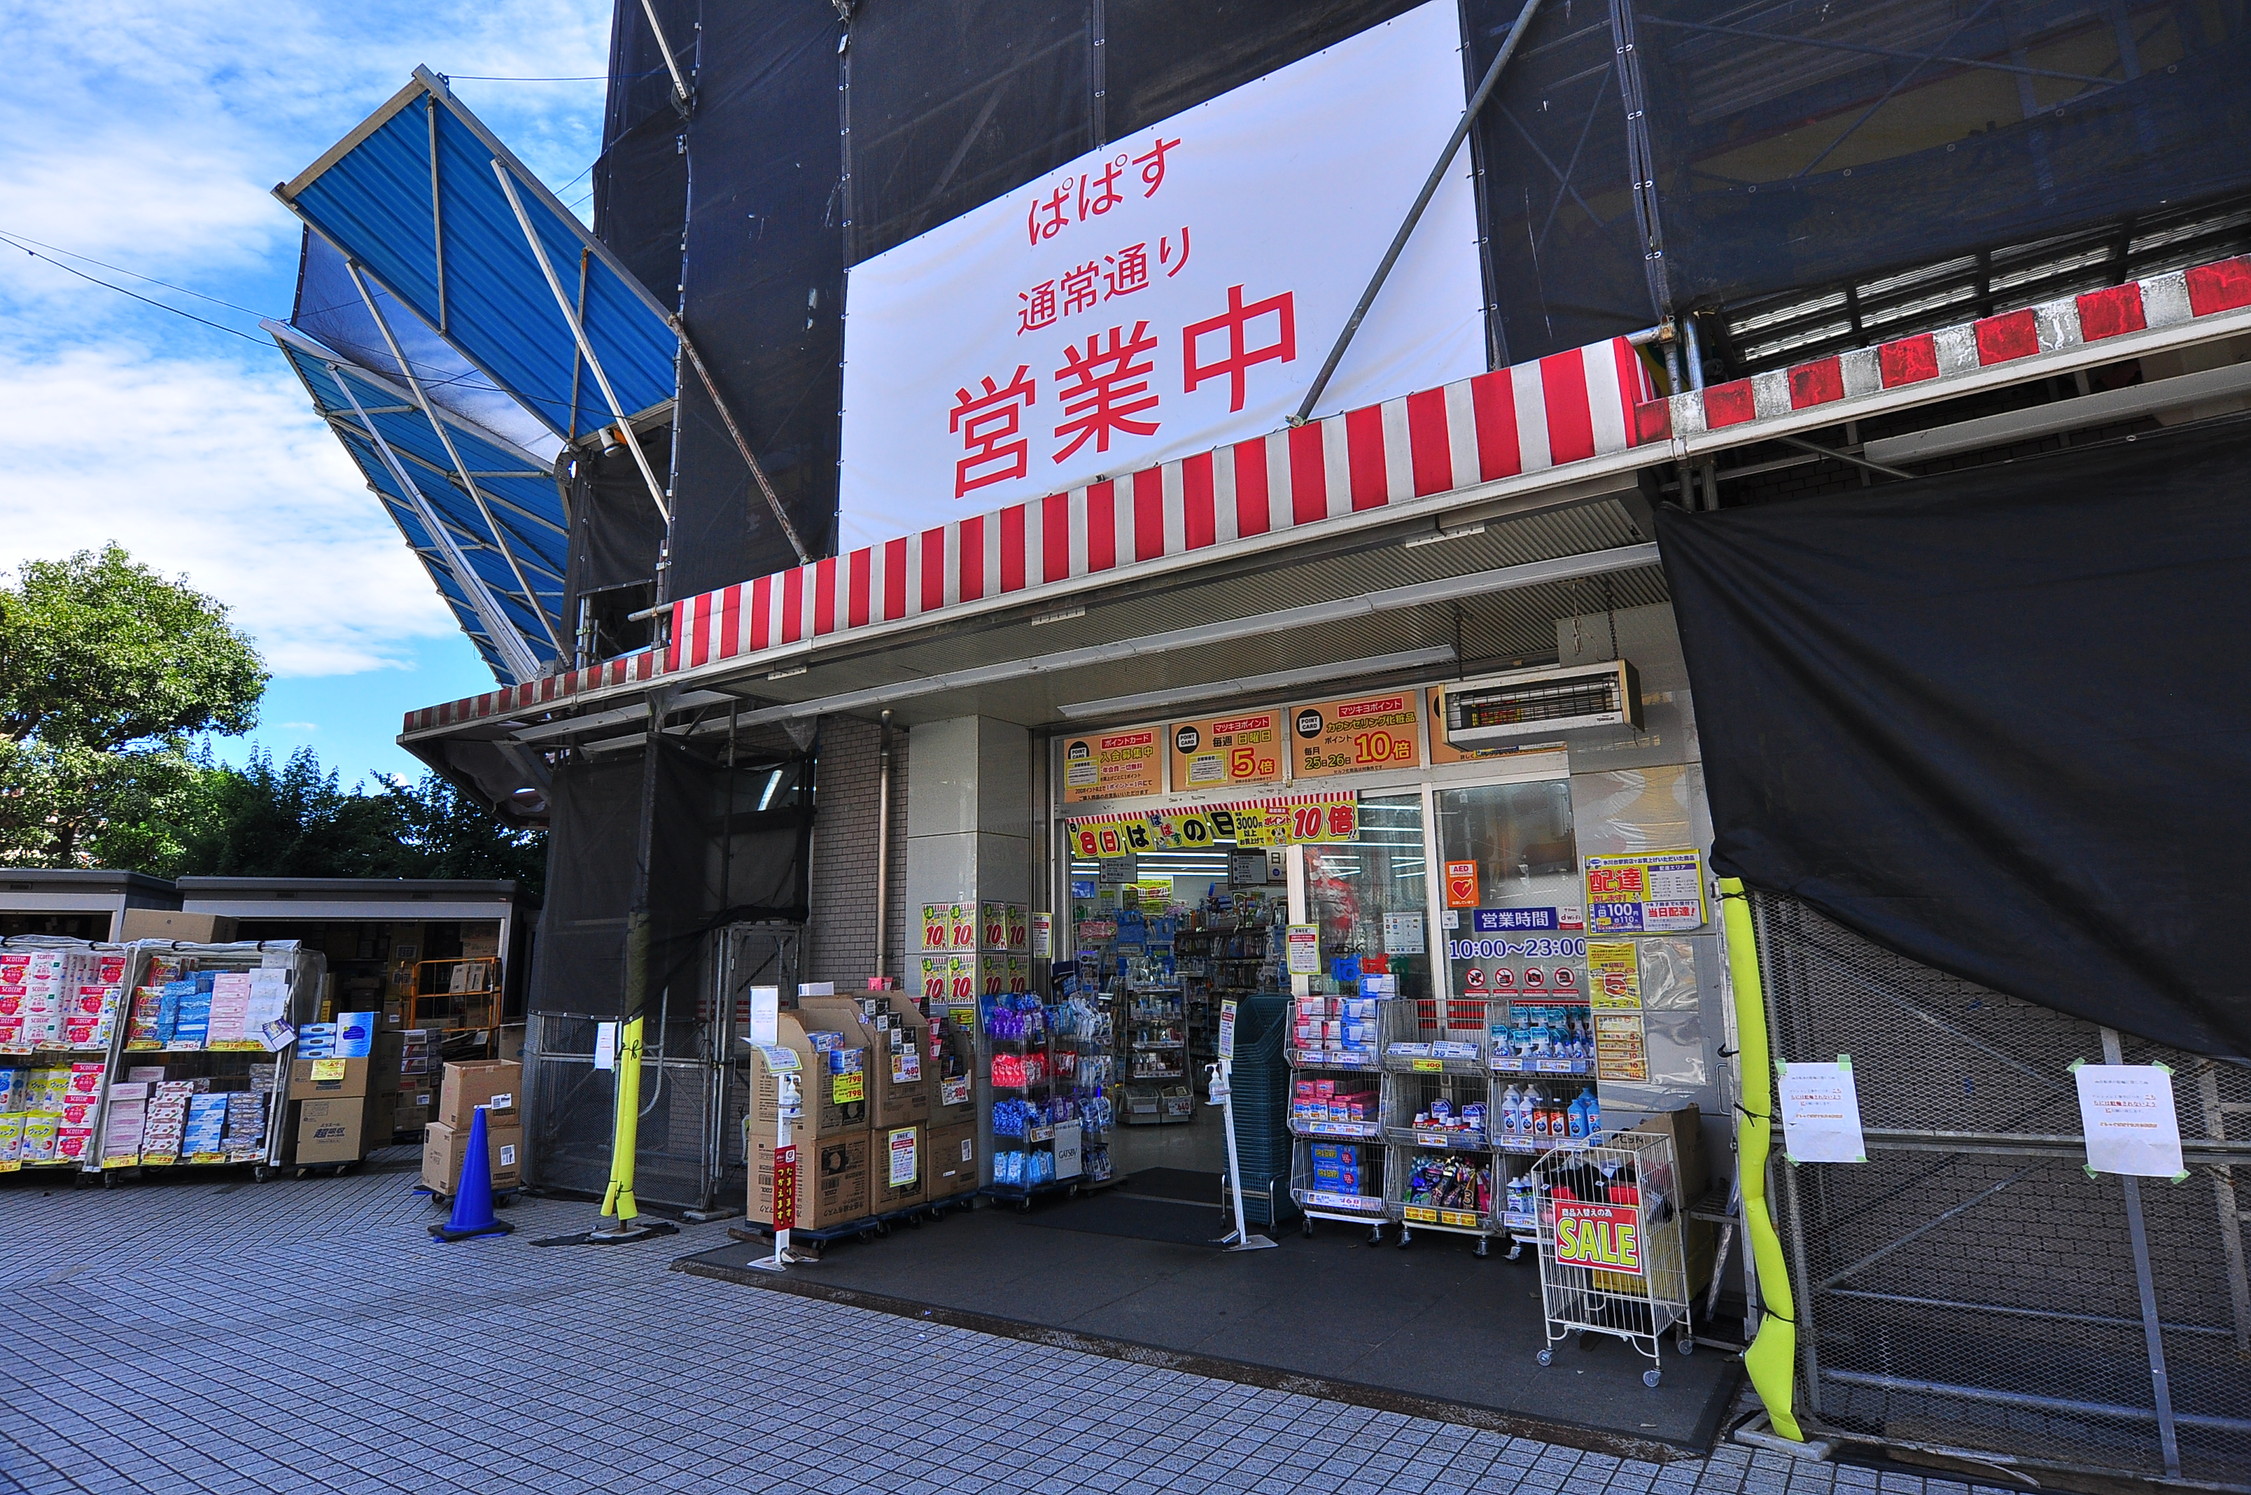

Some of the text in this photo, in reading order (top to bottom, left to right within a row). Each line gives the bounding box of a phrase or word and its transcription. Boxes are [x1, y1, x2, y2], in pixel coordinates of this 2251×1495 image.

[1027, 137, 1182, 246] ぱぱす
[1016, 226, 1191, 337] 通常通り
[949, 284, 1297, 500] 営業中
[1340, 700, 1402, 716] マツキヨポイント
[1214, 718, 1268, 733] マツキヨポイント
[1301, 717, 1318, 725] POINT
[1326, 711, 1417, 734] カウンセリング化粧品
[1103, 734, 1150, 748] ポイントカード
[1213, 729, 1272, 748] 毎週 日曜日
[1324, 734, 1352, 745] ポイント
[1354, 730, 1412, 764] 10倍
[1100, 745, 1154, 763] 入会募集中
[1304, 746, 1320, 756] 毎月
[1264, 815, 1292, 827] ポイント
[1453, 865, 1469, 873] AED
[1588, 866, 1643, 894] 配達
[1481, 910, 1549, 929] 営業時間
[1648, 906, 1696, 918] 当日配達!
[1561, 1208, 1613, 1218] 商品入替えの為
[1558, 1217, 1637, 1267] SALE
